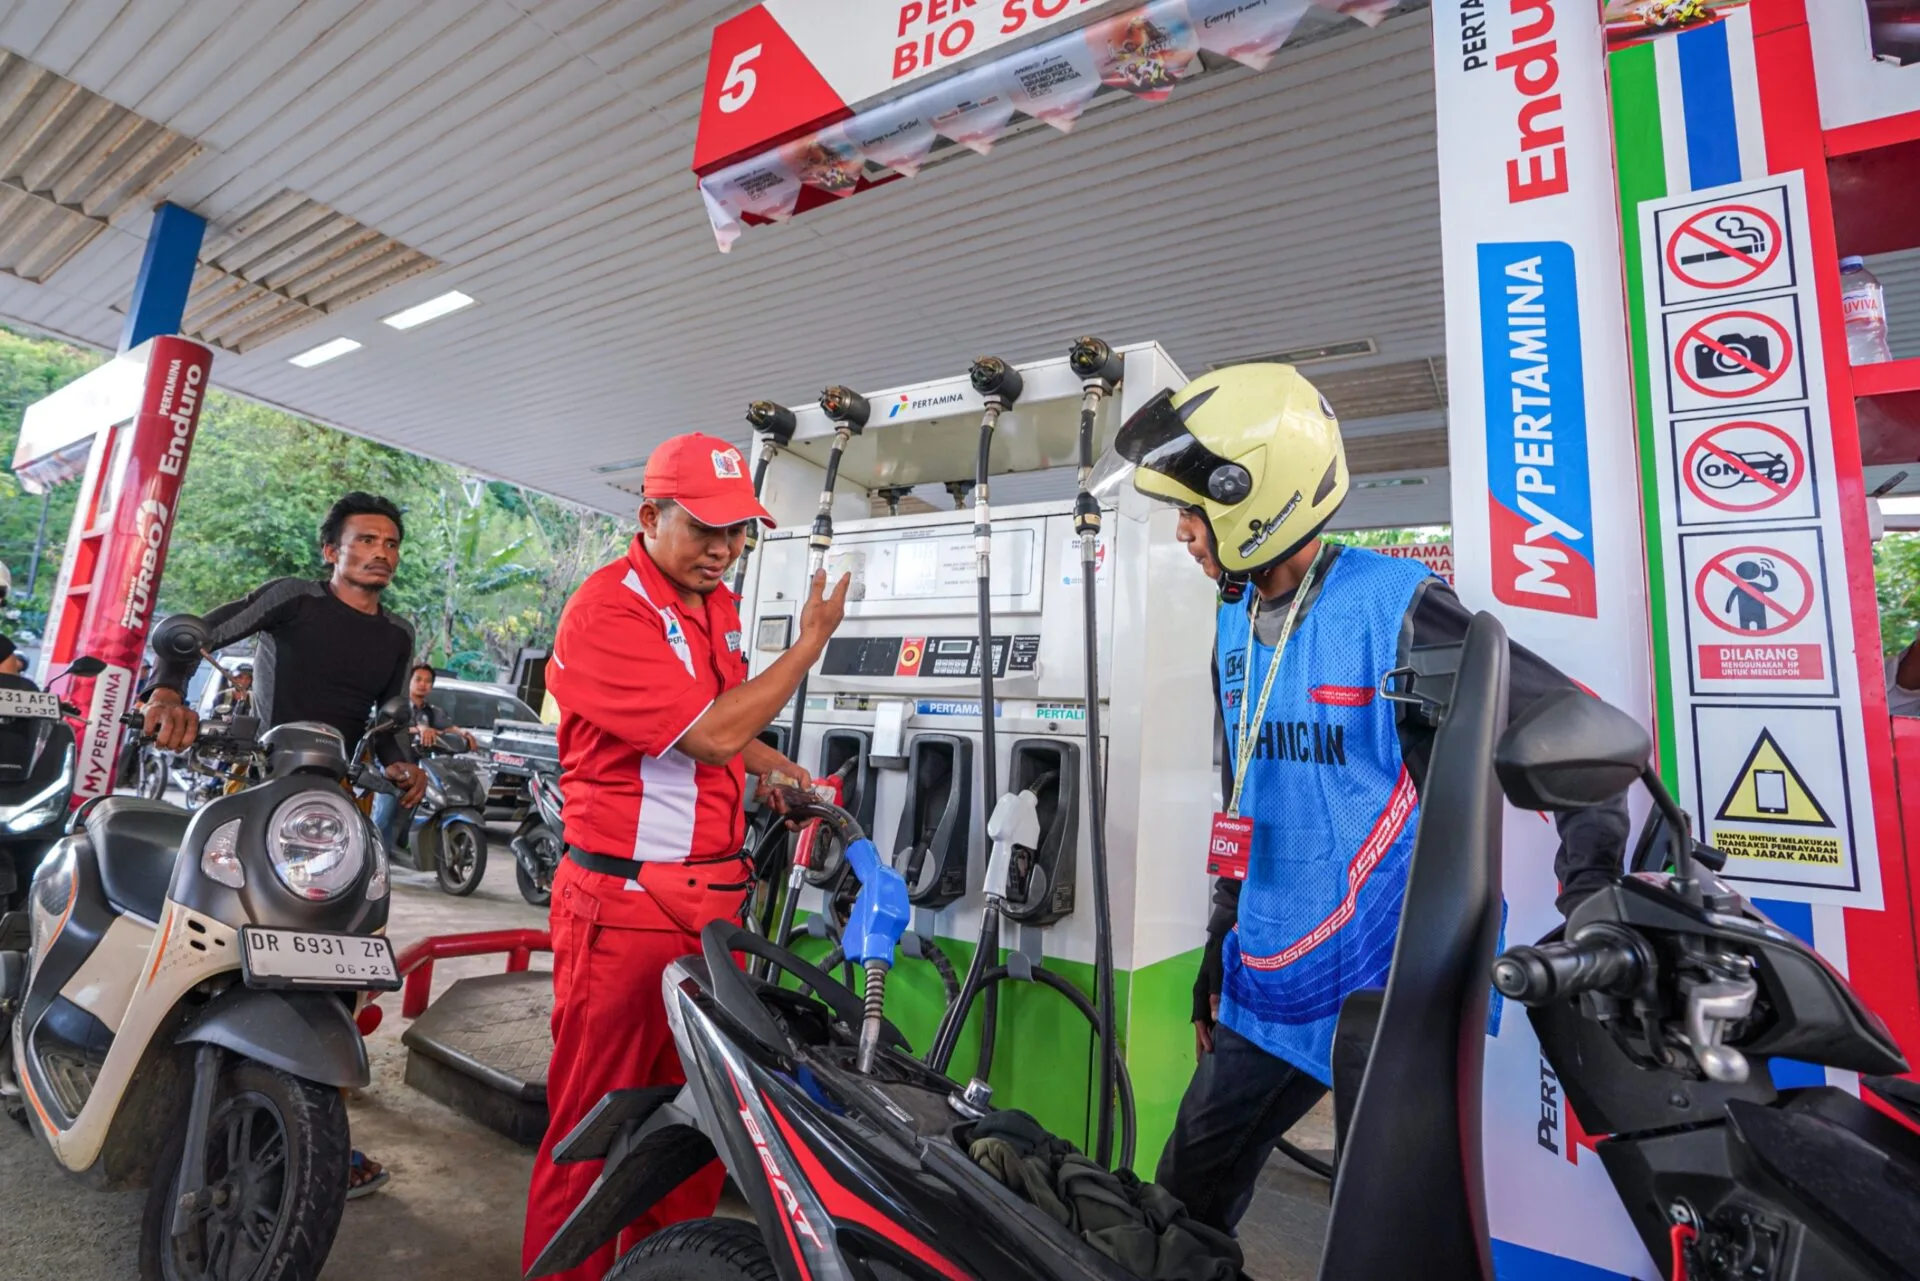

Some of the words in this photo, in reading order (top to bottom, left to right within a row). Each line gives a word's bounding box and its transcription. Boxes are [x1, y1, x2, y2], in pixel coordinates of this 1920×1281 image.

[892, 18, 975, 80] BIO
[1000, 0, 1090, 34] SO
[718, 43, 762, 113] 5
[158, 359, 182, 416] PERTAMINA
[912, 393, 963, 409] PERTAMINA
[158, 364, 202, 476] Enduro
[1704, 463, 1740, 477] ON
[1372, 544, 1453, 558] ERTAMA
[128, 522, 163, 630] TURBO
[1720, 648, 1798, 660] DILARANG
[1721, 661, 1783, 669] MENGGUNAKAN
[1787, 661, 1799, 669] HP
[1751, 668, 1800, 676] MENELEPON
[0, 693, 21, 703] 31
[29, 694, 56, 706] AFC
[929, 702, 983, 715] PERTAMA
[1037, 709, 1085, 720] PERTALI
[1212, 838, 1239, 855] IDN
[1716, 832, 1746, 841] HANYA
[1749, 835, 1777, 843] UNTUK
[1780, 837, 1837, 847] MELAKUKAN
[1717, 840, 1769, 849] TRANSAKSI
[1771, 843, 1838, 854] PEMBAYARAN
[1753, 849, 1795, 860] JARAK
[1798, 853, 1839, 864] AMAN
[251, 933, 279, 952] DR
[293, 936, 345, 956] 6931
[361, 941, 385, 958] ZP
[1537, 1050, 1559, 1156] PERT
